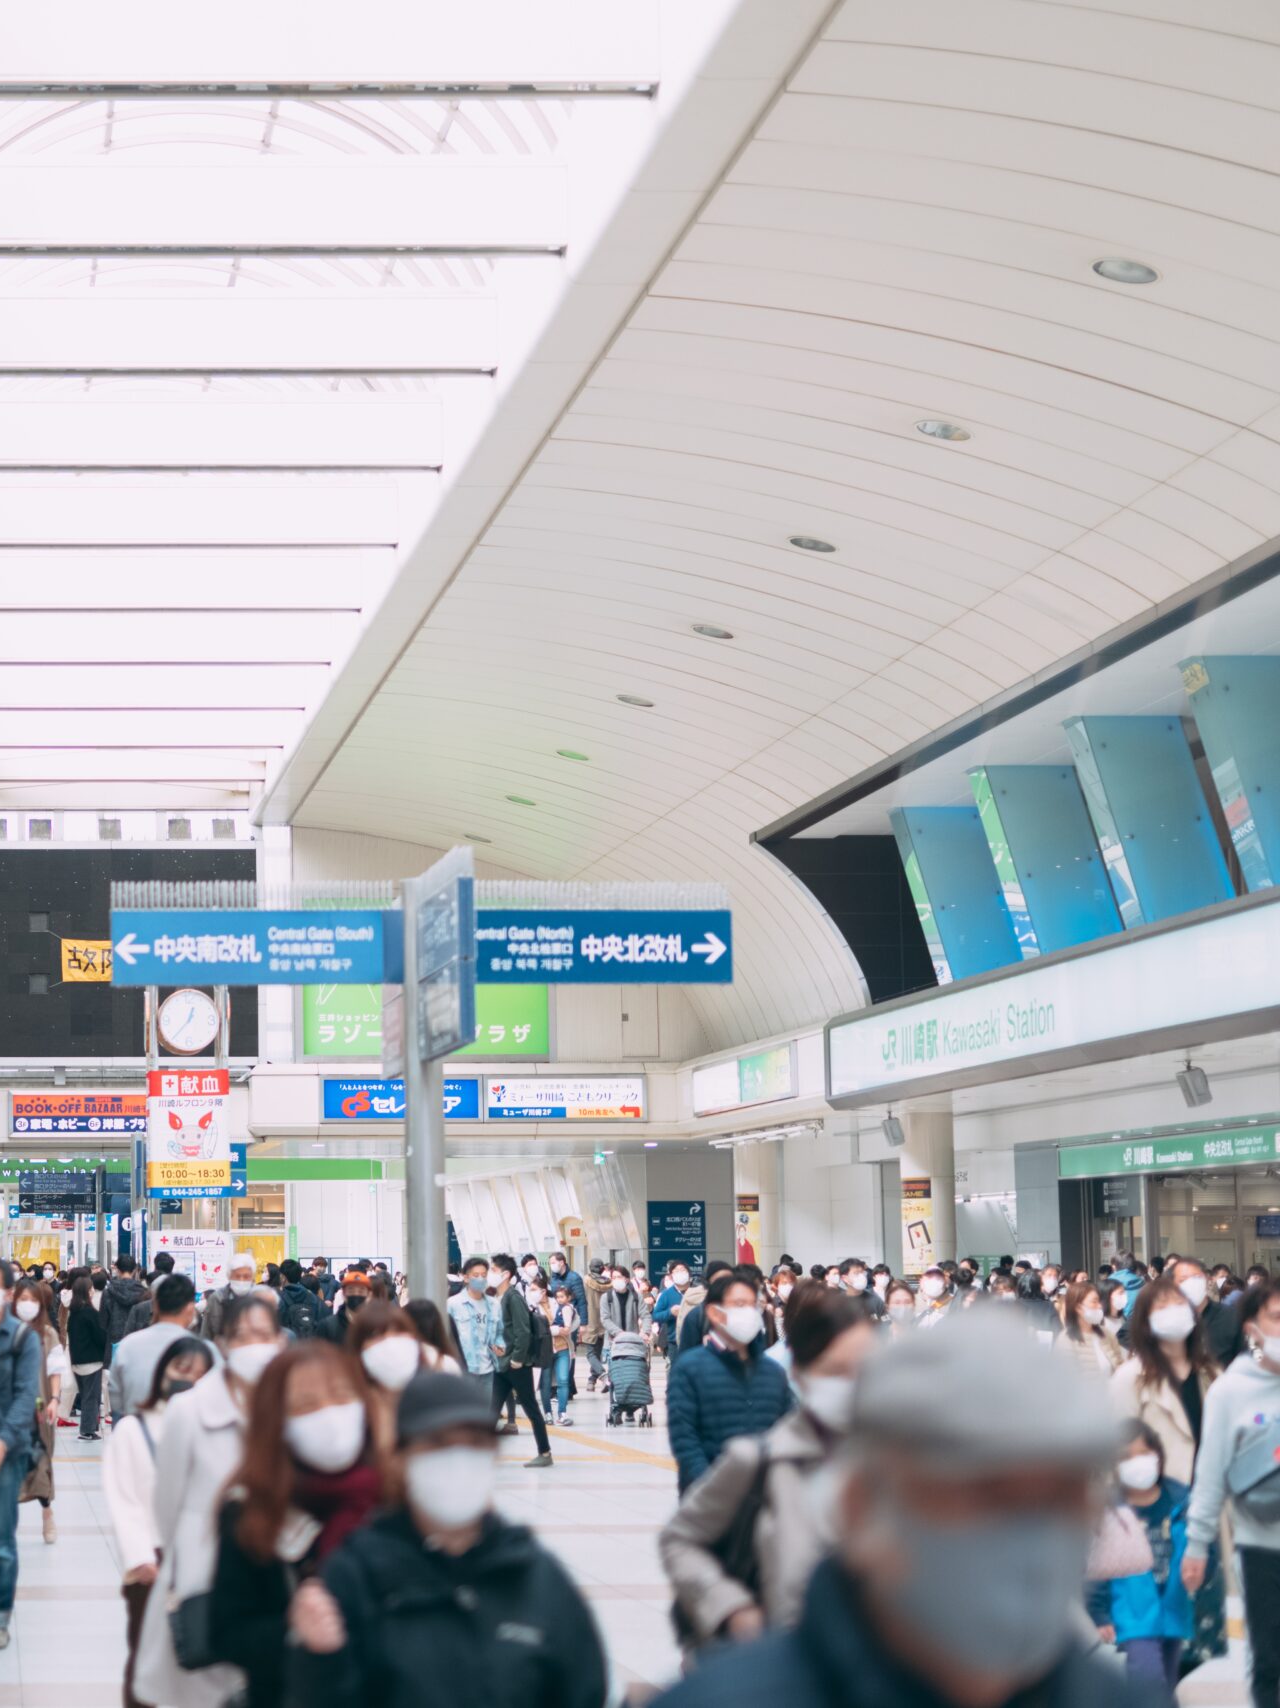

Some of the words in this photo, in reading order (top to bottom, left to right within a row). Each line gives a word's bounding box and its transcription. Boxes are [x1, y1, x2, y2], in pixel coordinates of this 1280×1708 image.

[267, 926, 306, 941] Central
[307, 926, 333, 941] Gate
[335, 925, 374, 942] (South)
[508, 926, 535, 941] Gate
[536, 925, 574, 942] (North)
[153, 934, 262, 964] 中央南改札
[580, 933, 688, 963] 中央北改札
[208, 1015, 215, 1026] 3
[318, 1013, 382, 1022] 三井ショッピン
[882, 1028, 896, 1062] JR
[900, 1018, 937, 1065] 川崎駅
[942, 1008, 1001, 1056] Kawasaki
[1006, 999, 1055, 1043] Station
[180, 1075, 220, 1094] 献血
[568, 1092, 638, 1102] こどもクリニック
[84, 1103, 123, 1113] BAZAAR
[171, 1188, 223, 1196] 044-245-1857
[173, 1236, 225, 1246] 献血ルーム
